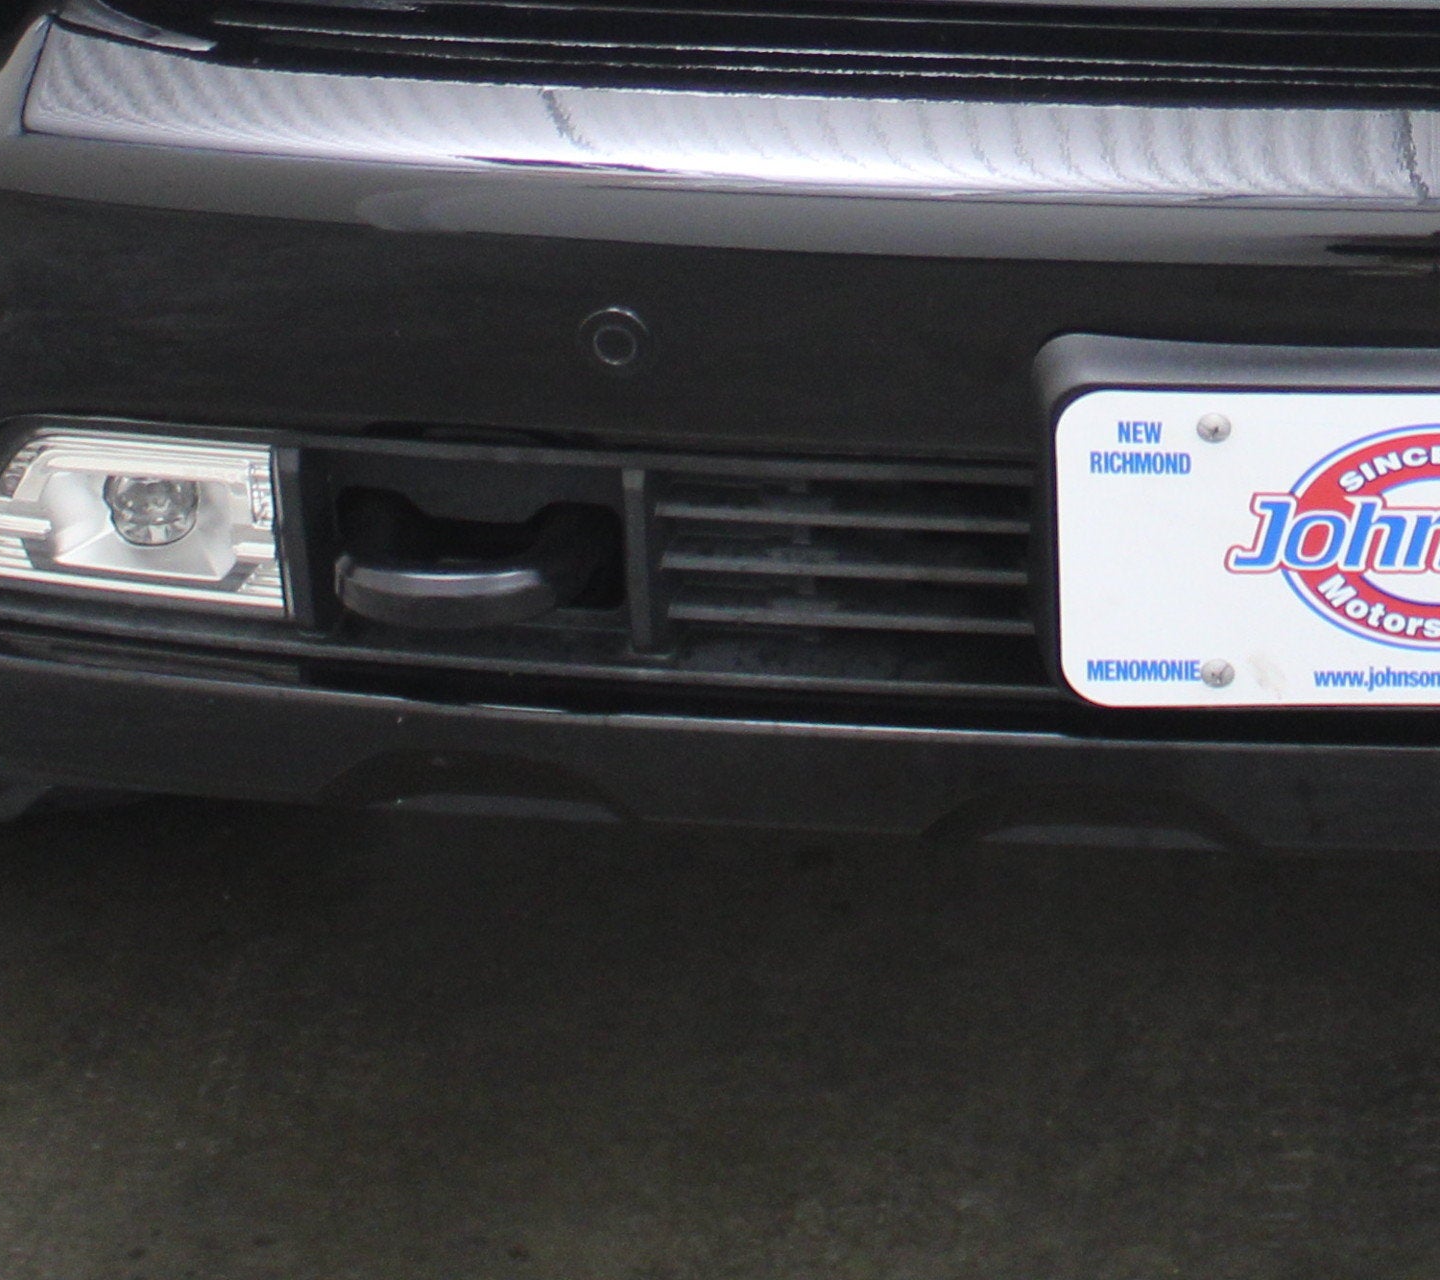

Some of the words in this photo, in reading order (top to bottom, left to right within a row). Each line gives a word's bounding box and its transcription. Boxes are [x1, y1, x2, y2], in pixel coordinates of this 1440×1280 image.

[1117, 421, 1163, 445] NEW
[1089, 451, 1192, 476] RICHMOND
[1086, 659, 1202, 683] MENOMONIE
